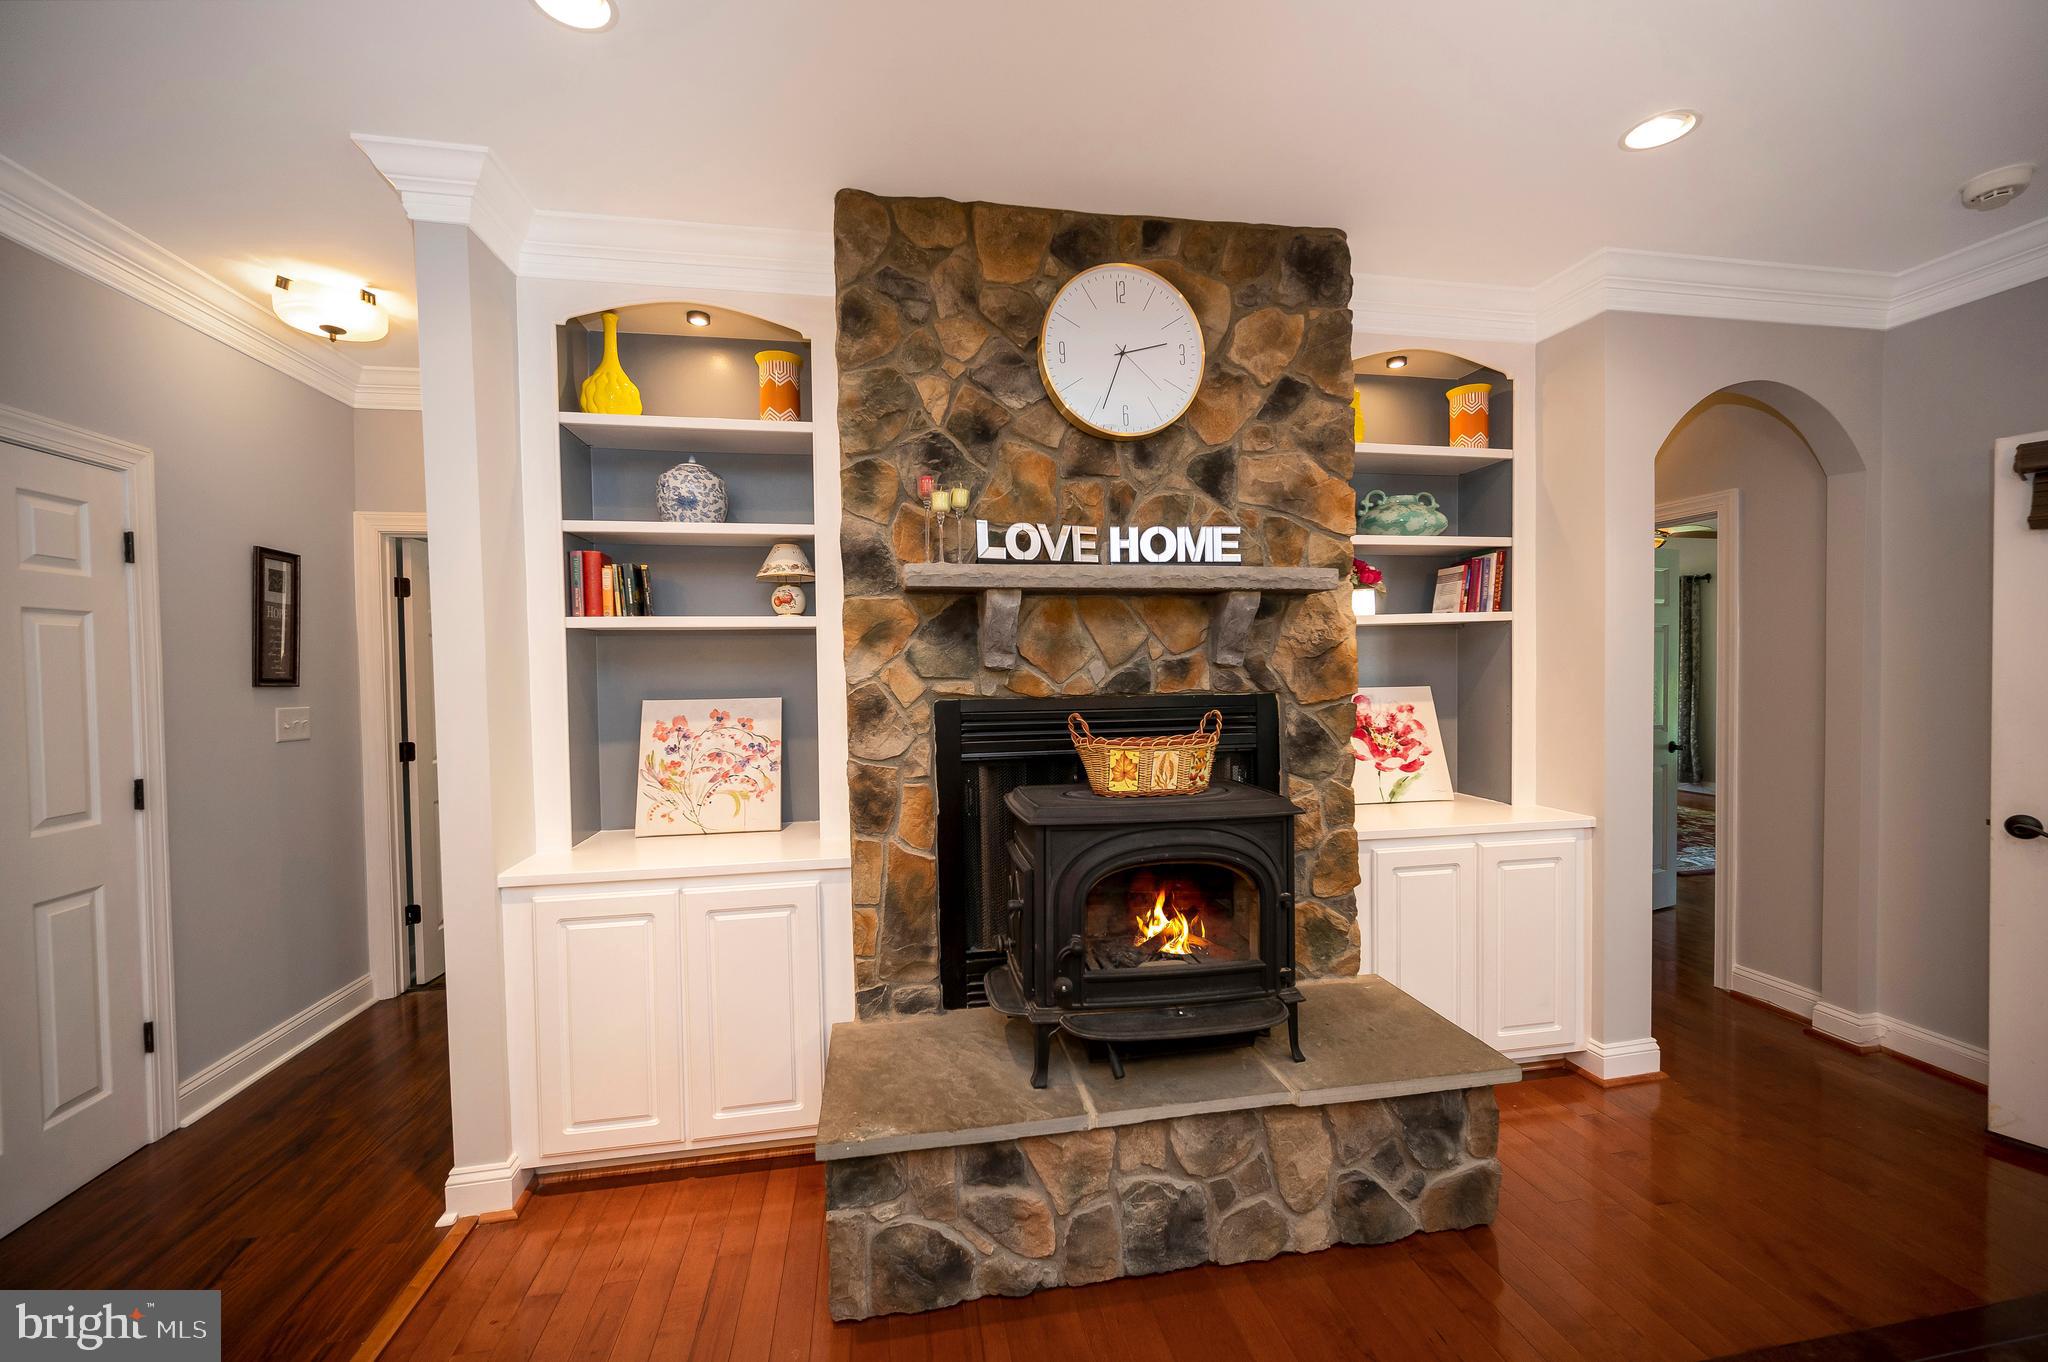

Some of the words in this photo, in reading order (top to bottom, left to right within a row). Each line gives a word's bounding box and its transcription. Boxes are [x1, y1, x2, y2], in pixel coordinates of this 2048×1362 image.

[1115, 280, 1126, 304] 12
[1058, 340, 1066, 364] 9
[1178, 343, 1186, 366] 3
[1122, 404, 1129, 426] 6
[976, 519, 1100, 563] LOVE
[1109, 526, 1241, 564] HOME
